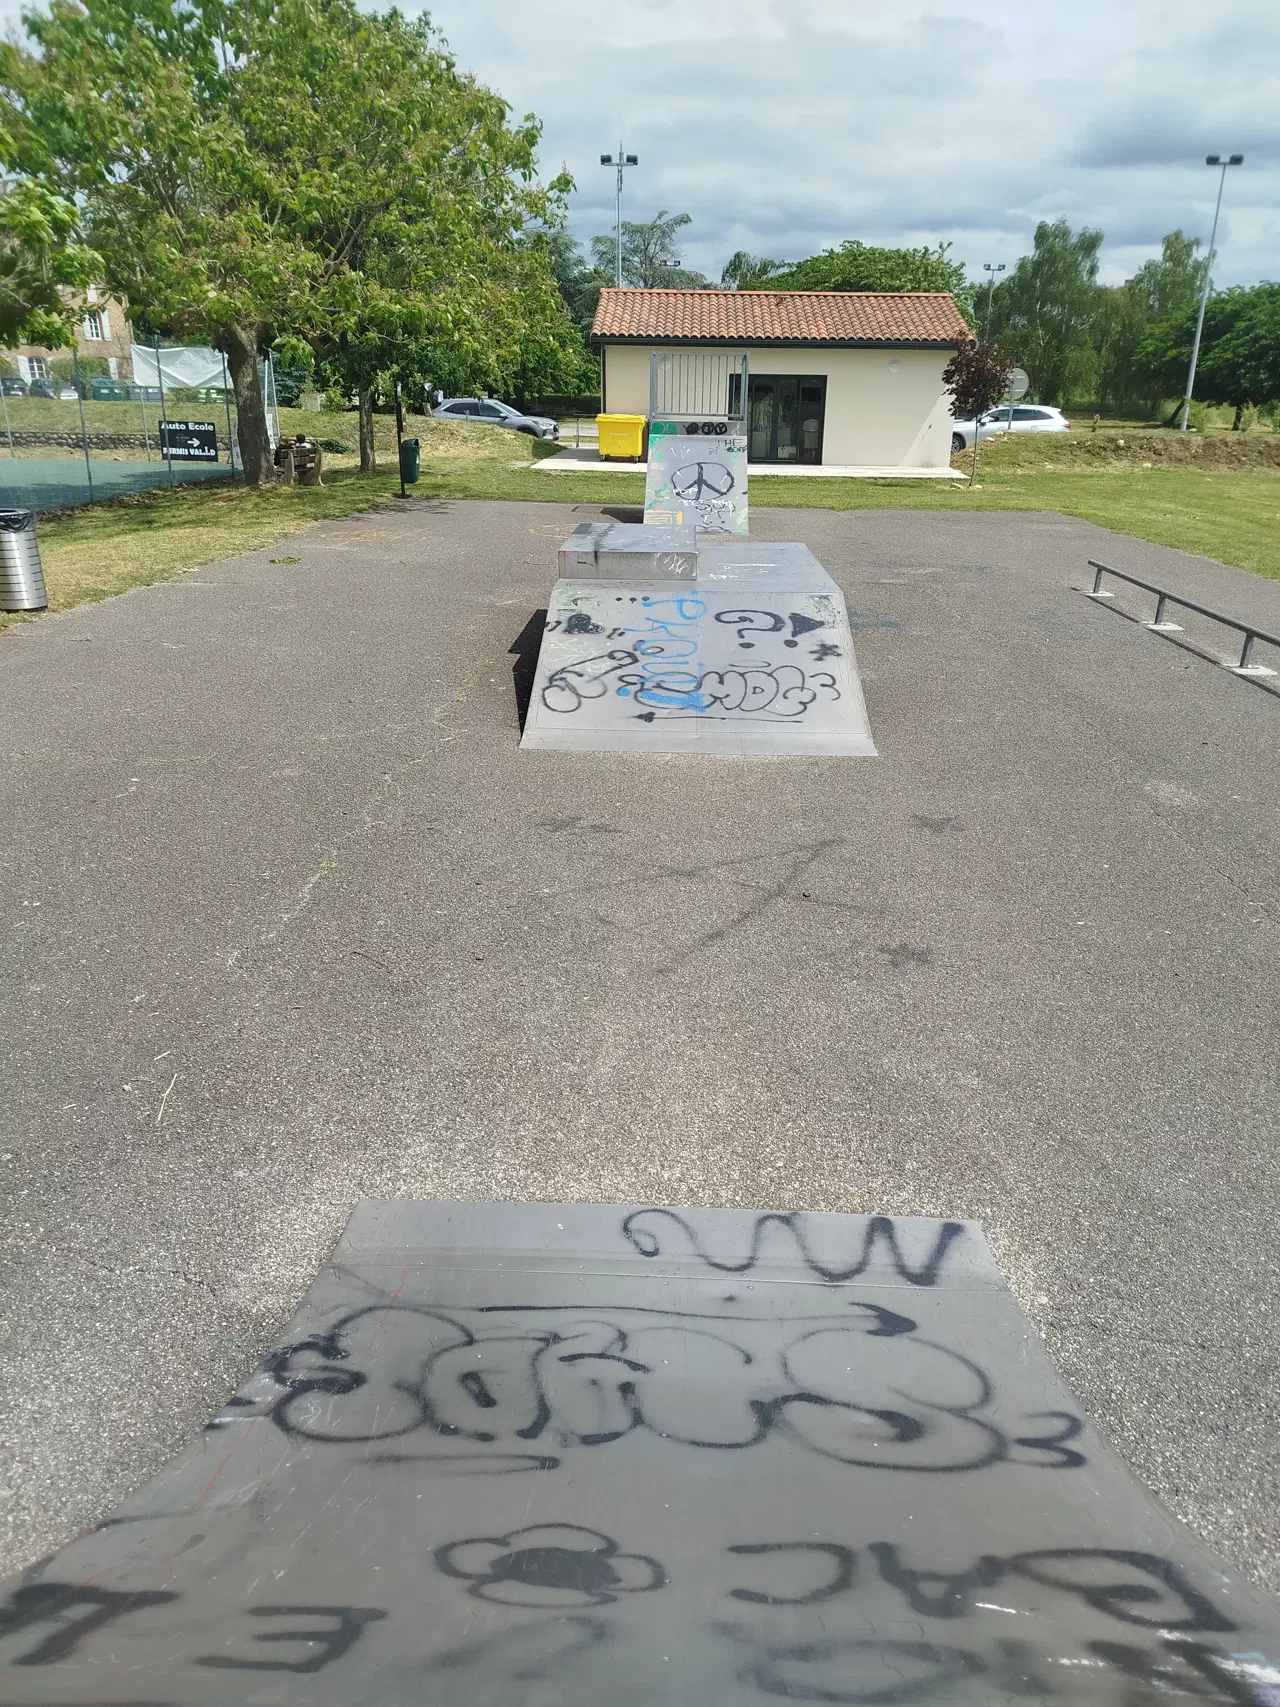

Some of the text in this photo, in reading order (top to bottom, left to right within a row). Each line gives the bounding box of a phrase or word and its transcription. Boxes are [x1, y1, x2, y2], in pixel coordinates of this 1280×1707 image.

[161, 422, 214, 431] Auto Ecole
[162, 447, 189, 456] PERMIS
